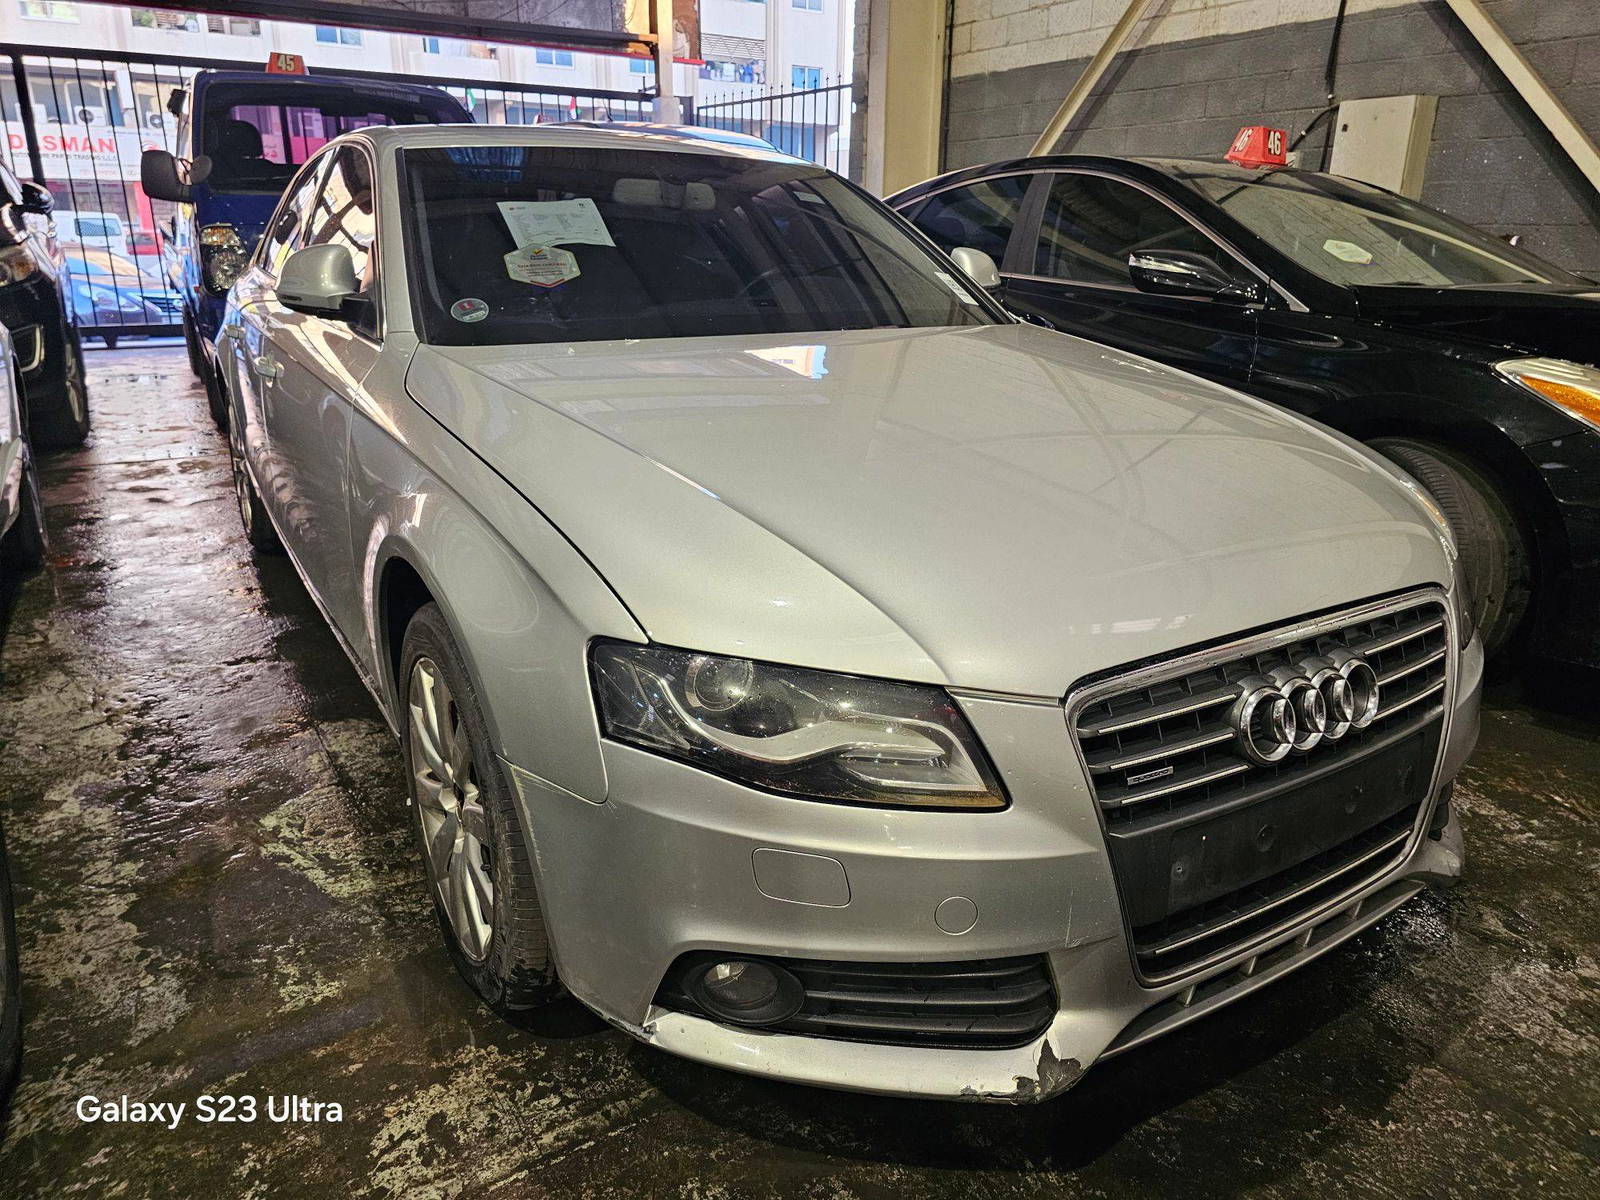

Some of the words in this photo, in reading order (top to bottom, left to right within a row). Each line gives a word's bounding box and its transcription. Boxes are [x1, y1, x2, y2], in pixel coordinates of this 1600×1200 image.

[278, 54, 295, 72] 45
[8, 134, 115, 153] DSMAN
[1234, 128, 1253, 152] 46
[1268, 130, 1281, 156] 46
